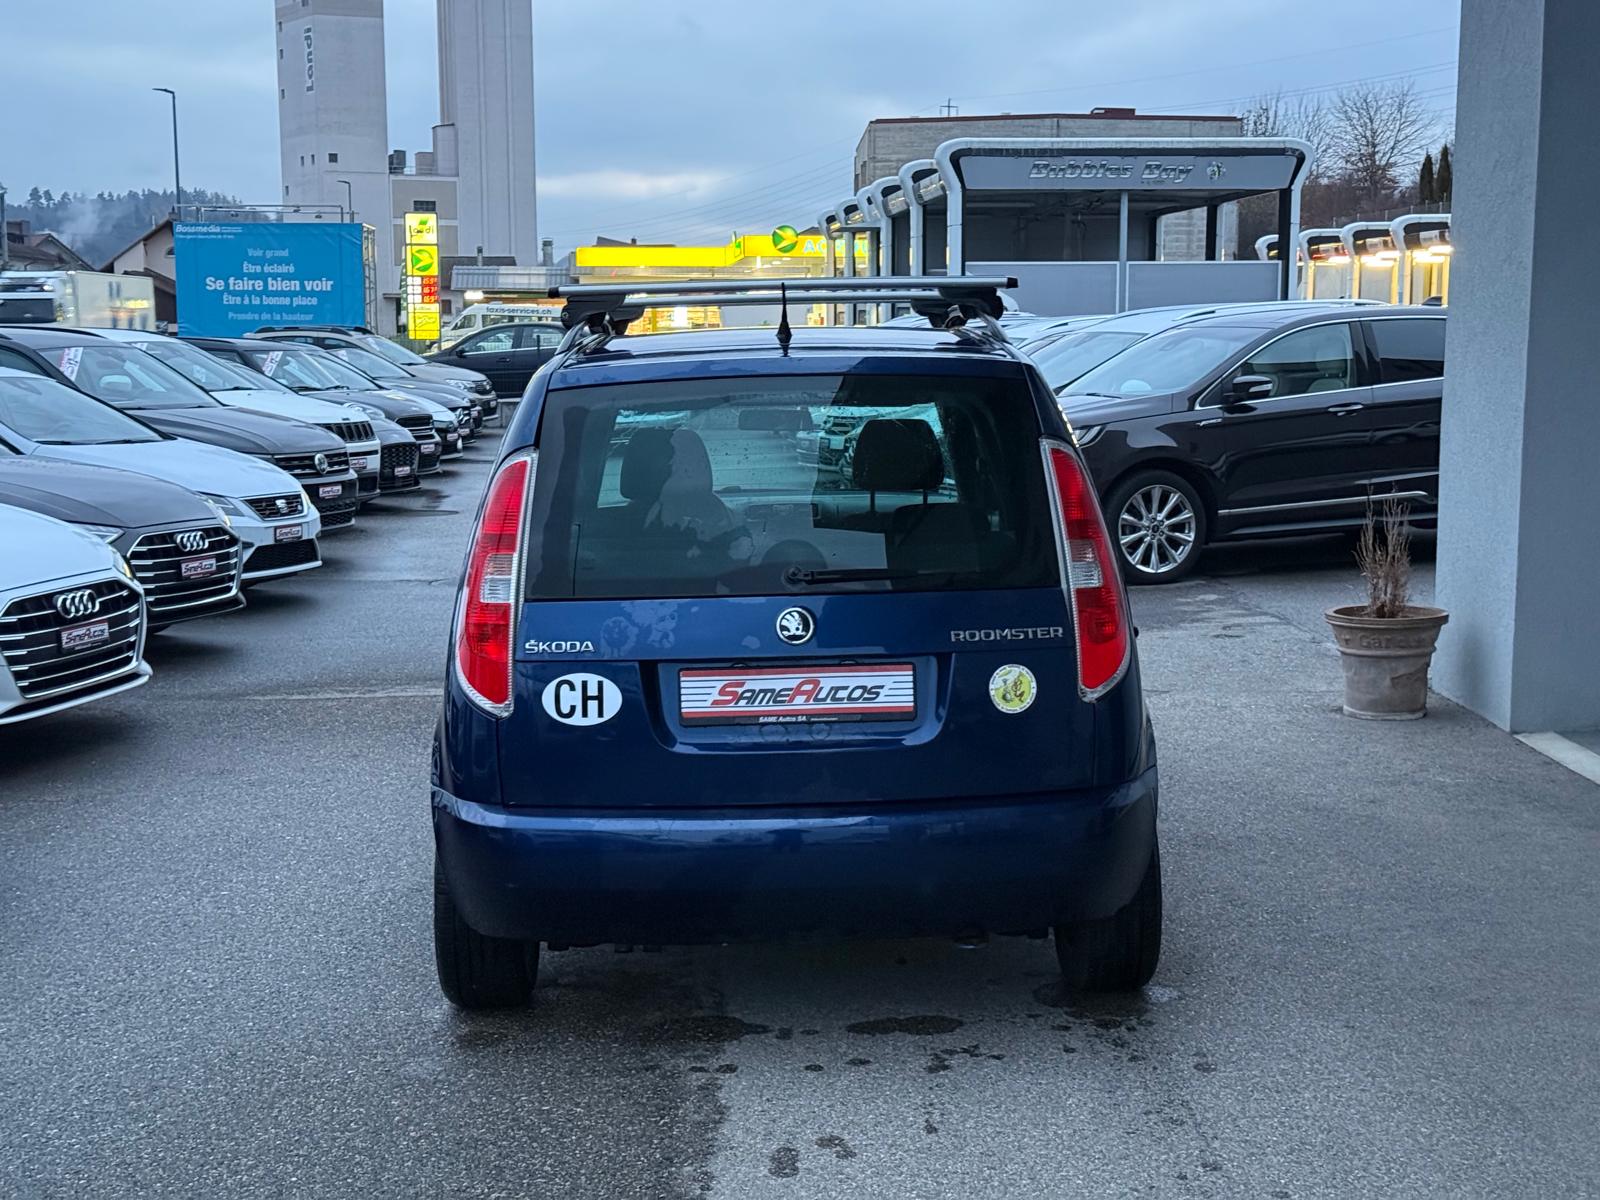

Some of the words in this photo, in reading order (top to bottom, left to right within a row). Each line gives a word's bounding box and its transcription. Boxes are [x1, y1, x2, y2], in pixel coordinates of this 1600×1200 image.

[303, 27, 315, 92] Landi
[1029, 160, 1135, 179] Bubbles
[1142, 160, 1195, 183] Bay
[175, 224, 221, 233] Bossmedia
[247, 248, 264, 257] Voir
[265, 248, 289, 258] grand
[243, 261, 261, 273] Être
[264, 263, 295, 273] éclairé
[205, 276, 225, 290] Se
[228, 276, 264, 291] faire
[267, 277, 301, 291] bien
[304, 278, 334, 291] voir
[223, 292, 242, 305] Être
[243, 294, 250, 305] à
[252, 294, 260, 305] la
[262, 295, 291, 305] bonne
[293, 295, 318, 307] place
[228, 311, 260, 320] Prendre
[261, 311, 271, 320] de
[273, 311, 281, 320] la
[282, 312, 314, 321] hauteur
[486, 306, 552, 315] taxis-services.ch
[950, 626, 1064, 642] ROOMSTER
[525, 640, 595, 654] ŠKODA
[554, 679, 604, 719] CH
